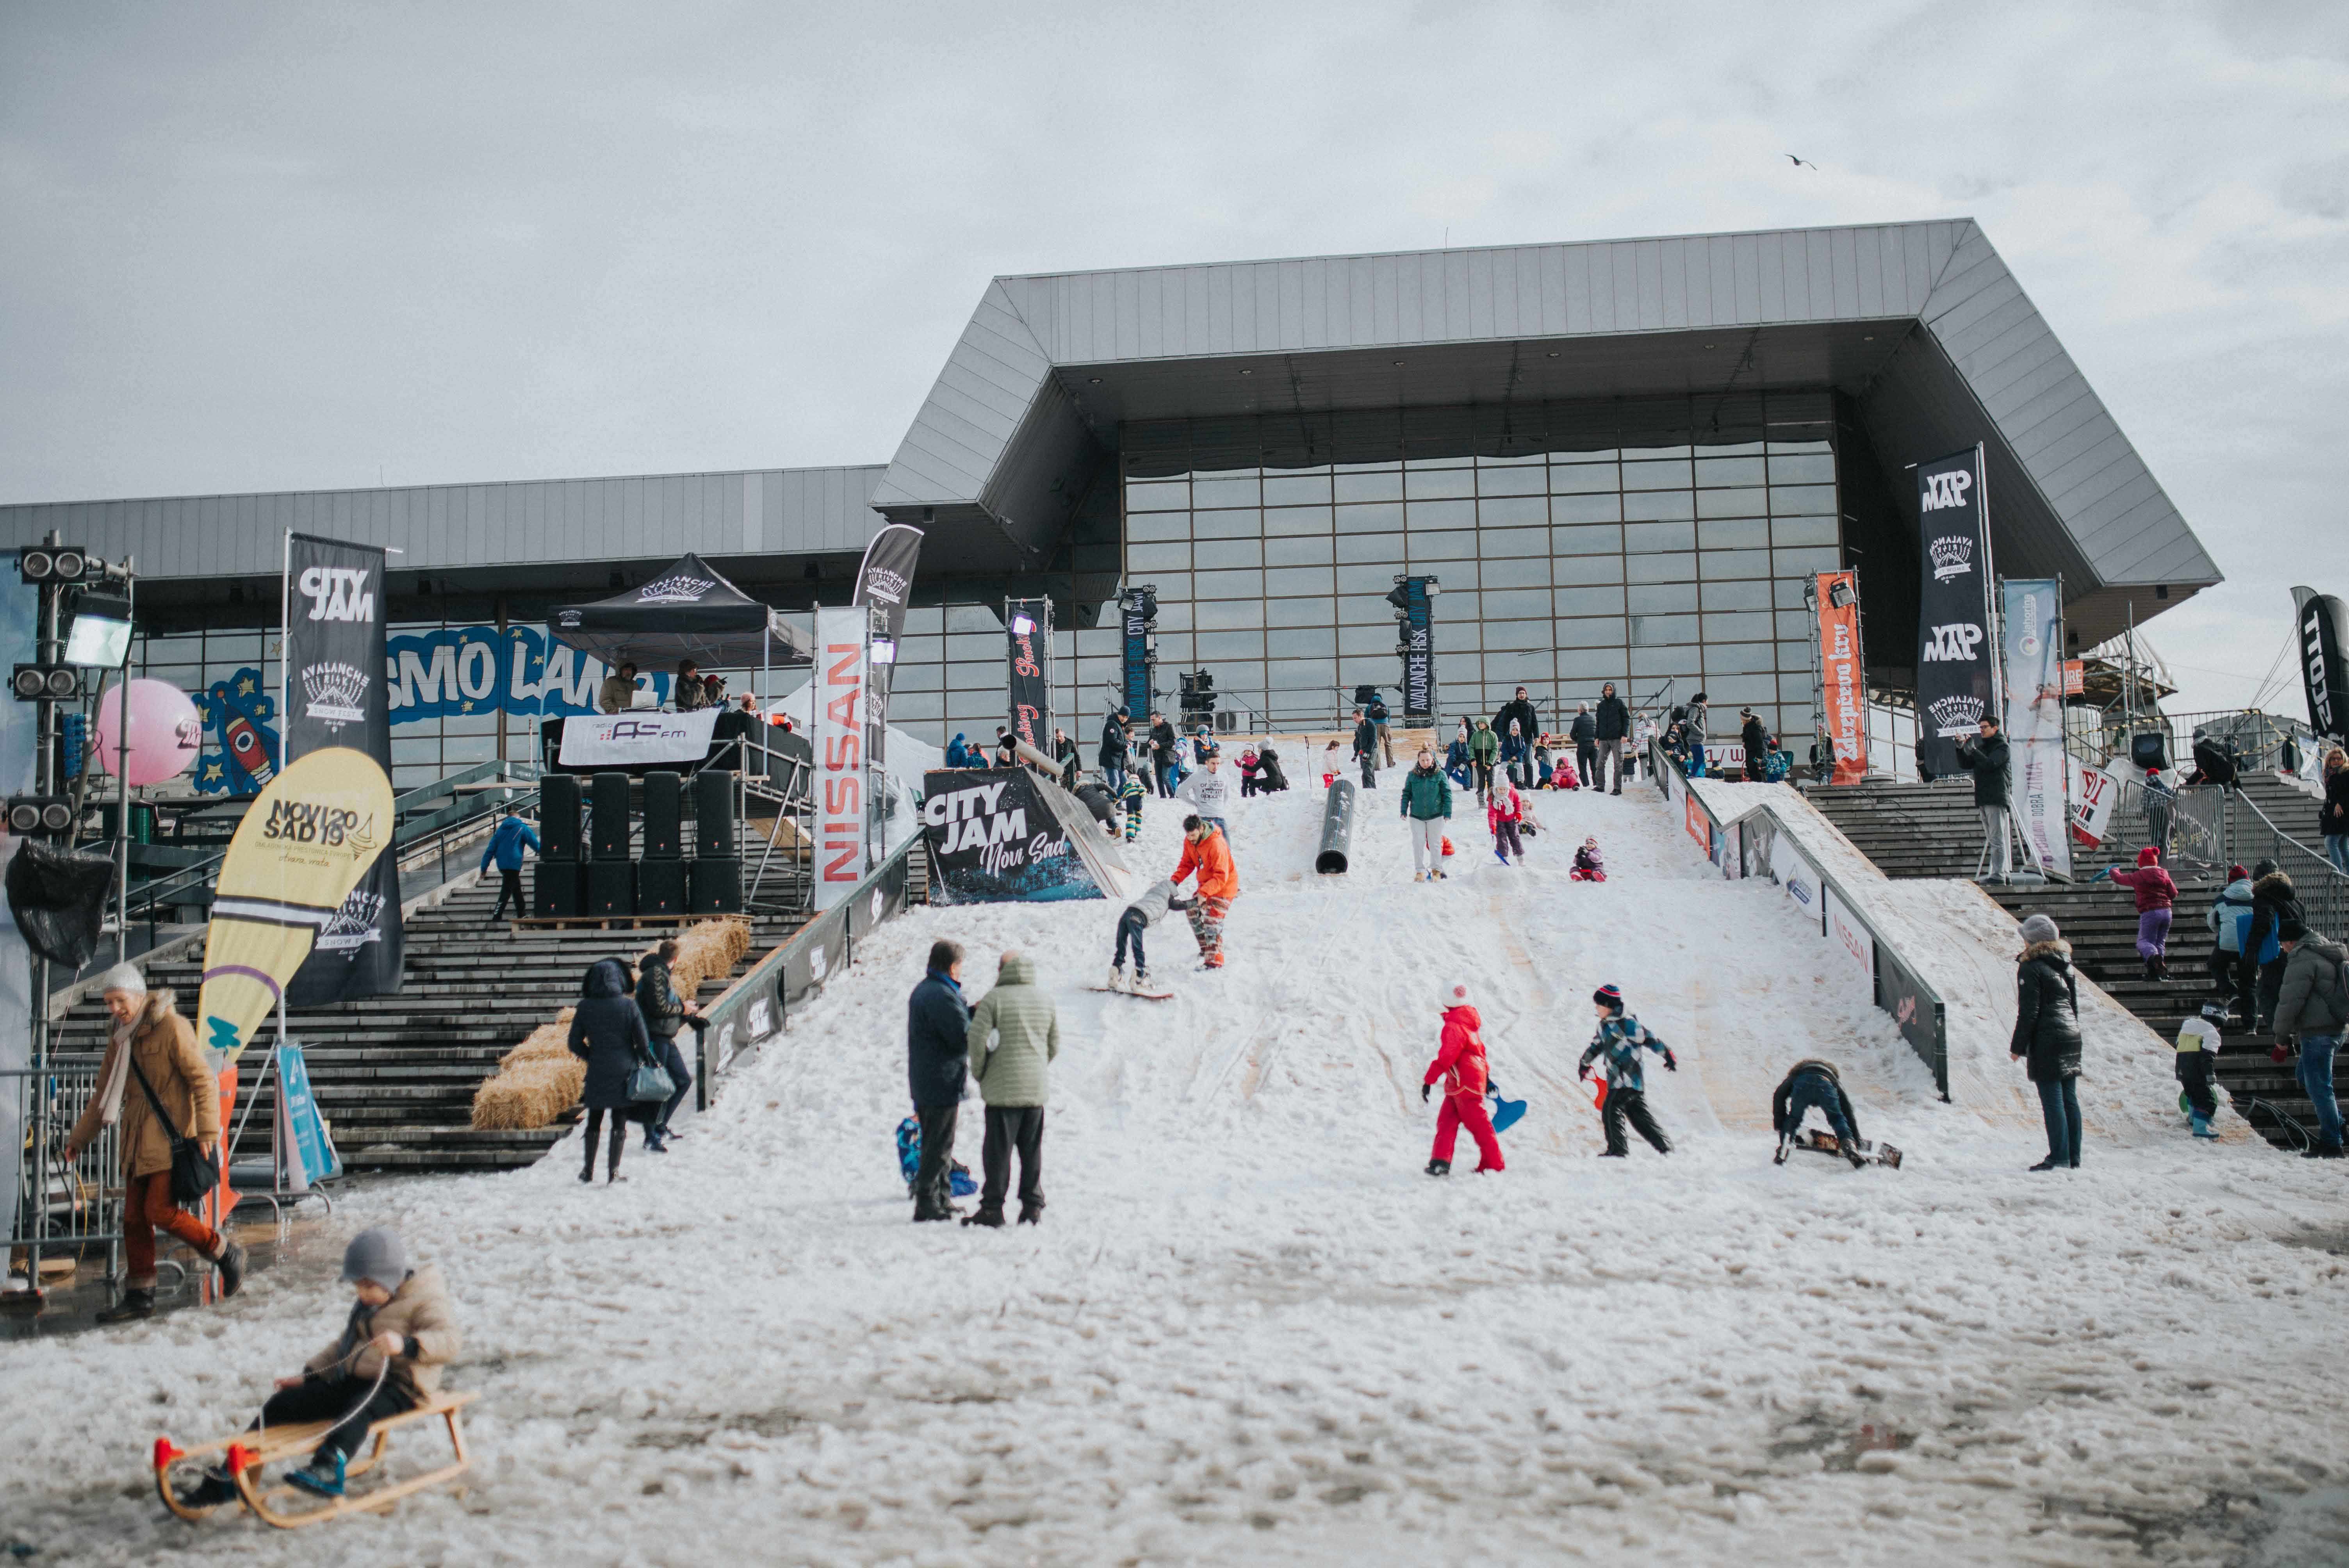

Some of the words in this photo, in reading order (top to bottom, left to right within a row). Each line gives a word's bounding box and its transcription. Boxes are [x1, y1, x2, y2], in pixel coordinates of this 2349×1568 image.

[300, 567, 369, 597] CITY
[642, 576, 715, 593] AVALANCHE
[868, 567, 907, 587] AVALANCHE
[308, 592, 374, 622] JAM
[1409, 606, 1426, 625] CITY
[1127, 616, 1144, 635] CITY
[1410, 628, 1427, 650] RISK
[1016, 622, 1039, 677] Smoki
[1127, 638, 1144, 661] RISK
[302, 661, 370, 688] AVALANCHE
[324, 674, 348, 686] RISK
[1410, 654, 1427, 710] AVALANCHE
[1128, 663, 1146, 718] AVALANCHE
[611, 721, 661, 740] AS
[824, 643, 861, 882] NISSAN
[2024, 762, 2043, 791] ZIMA
[271, 799, 329, 830] NOVI
[925, 781, 1007, 826] CITY
[2029, 793, 2044, 816] DOBRA
[263, 817, 316, 843] SAD
[940, 808, 1027, 854] JAM
[308, 857, 330, 867] vrata
[980, 841, 1024, 878] Novi
[1028, 831, 1067, 864] Sad
